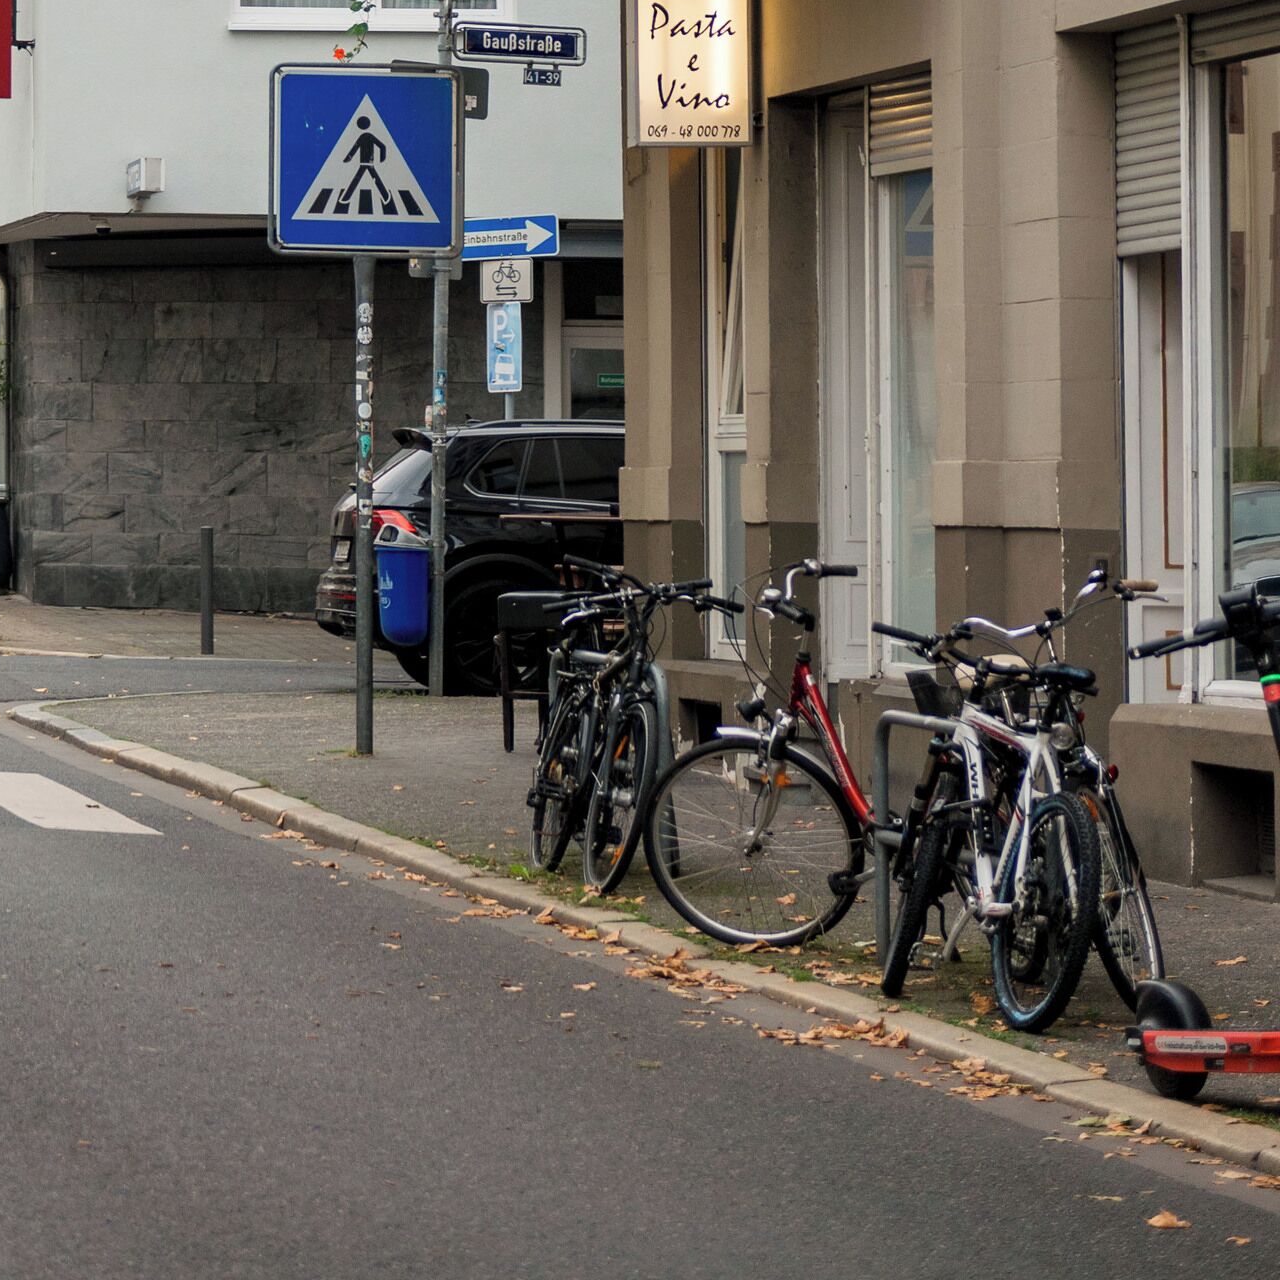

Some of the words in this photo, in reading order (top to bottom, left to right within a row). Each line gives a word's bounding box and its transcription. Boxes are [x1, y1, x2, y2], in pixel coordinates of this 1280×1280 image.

[650, 2, 736, 40] Pasta
[482, 32, 562, 54] Gaußstraße
[687, 54, 699, 72] e
[526, 72, 560, 85] 41-39
[657, 73, 730, 110] Vino
[647, 124, 668, 138] 069
[679, 124, 693, 138] 48
[697, 125, 719, 138] 000
[721, 124, 741, 138] 778
[463, 231, 528, 245] Einbahnstraße
